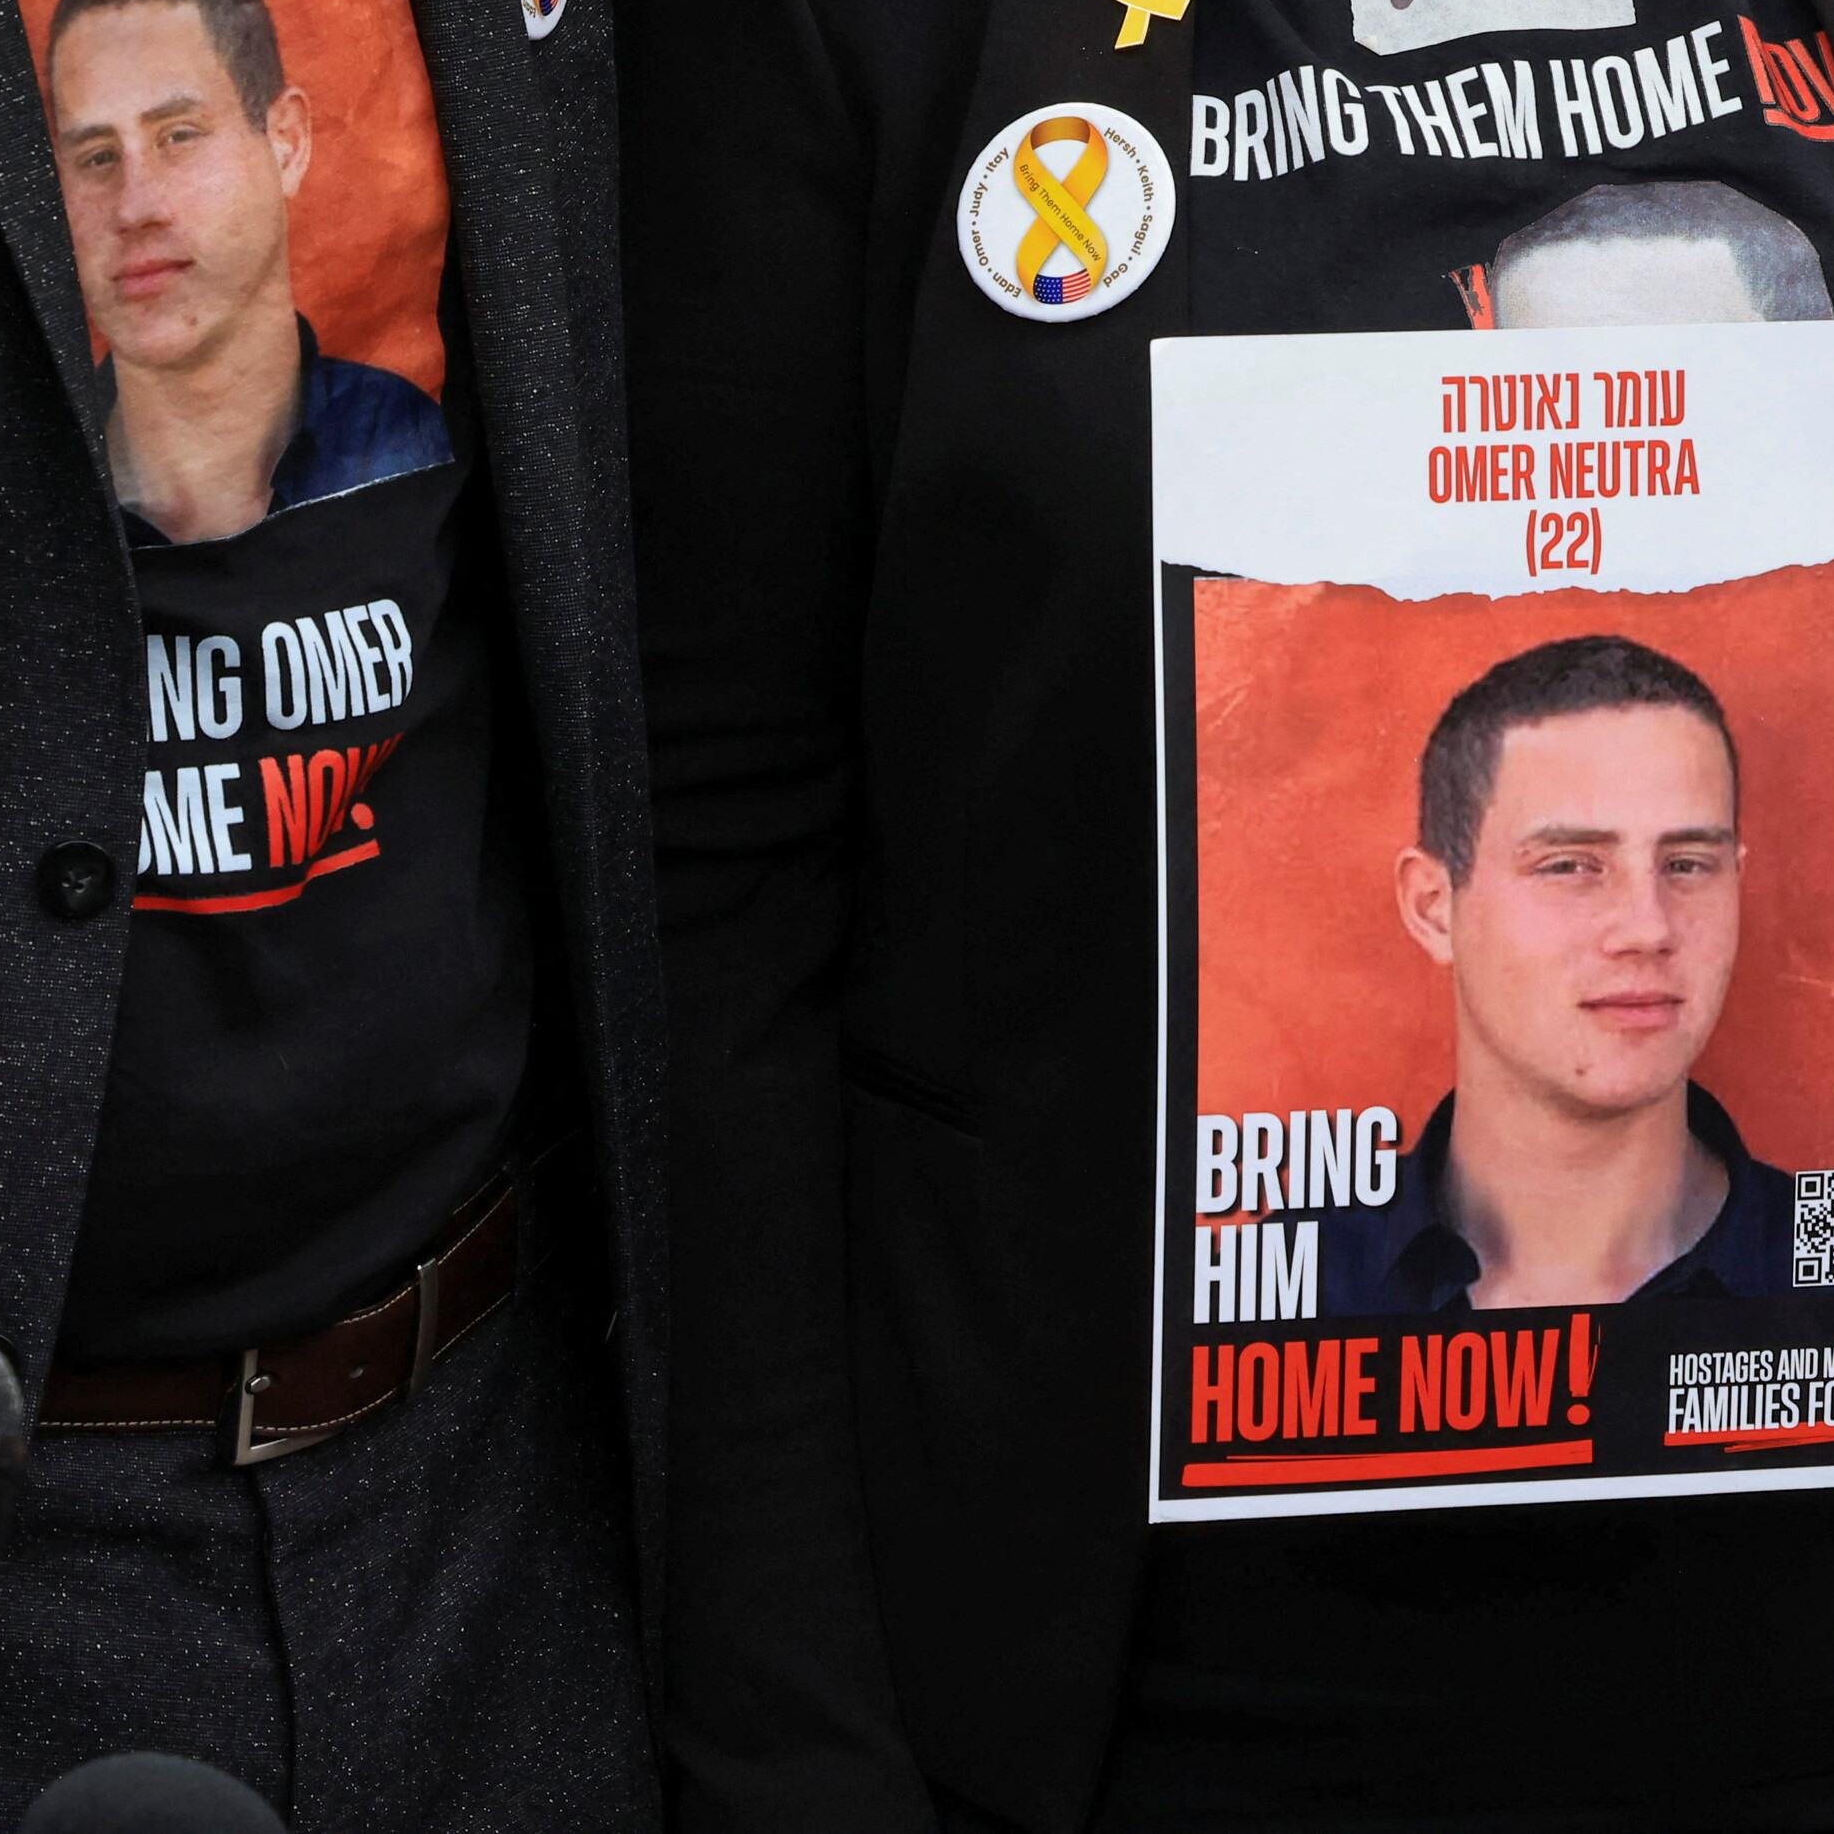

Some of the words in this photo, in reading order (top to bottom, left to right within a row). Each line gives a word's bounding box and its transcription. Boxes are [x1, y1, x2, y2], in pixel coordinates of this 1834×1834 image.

[1190, 65, 1369, 182] BRING
[1365, 60, 1544, 160] THEM
[1550, 20, 1743, 158] HOME
[985, 146, 1010, 173] Itay
[1103, 127, 1137, 159] Hersh
[969, 182, 988, 217] Judy
[1137, 165, 1155, 202] Keith
[1019, 163, 1040, 193] Bring
[1038, 188, 1061, 216] Them
[1060, 213, 1084, 241] Home
[1082, 238, 1102, 262] Now
[1130, 214, 1153, 256] Sagui
[971, 229, 989, 267] Omer
[1103, 262, 1129, 288] Gad
[992, 271, 1022, 298] Edan
[1442, 373, 1579, 433] נאוטרה
[1594, 369, 1685, 428] עומר
[1428, 444, 1536, 504] OMER
[1549, 438, 1700, 499] NEUTRA
[1526, 507, 1601, 577] (22)
[261, 599, 413, 730] OMER
[1195, 1106, 1397, 1214] BRING
[1193, 1221, 1319, 1324] HIM
[1191, 1338, 1379, 1444] HOME
[1399, 1313, 1601, 1433] NOW!
[1669, 1350, 1774, 1386] HOSTAGES
[1777, 1348, 1818, 1381] AND
[1668, 1382, 1801, 1434] FAMILIES
